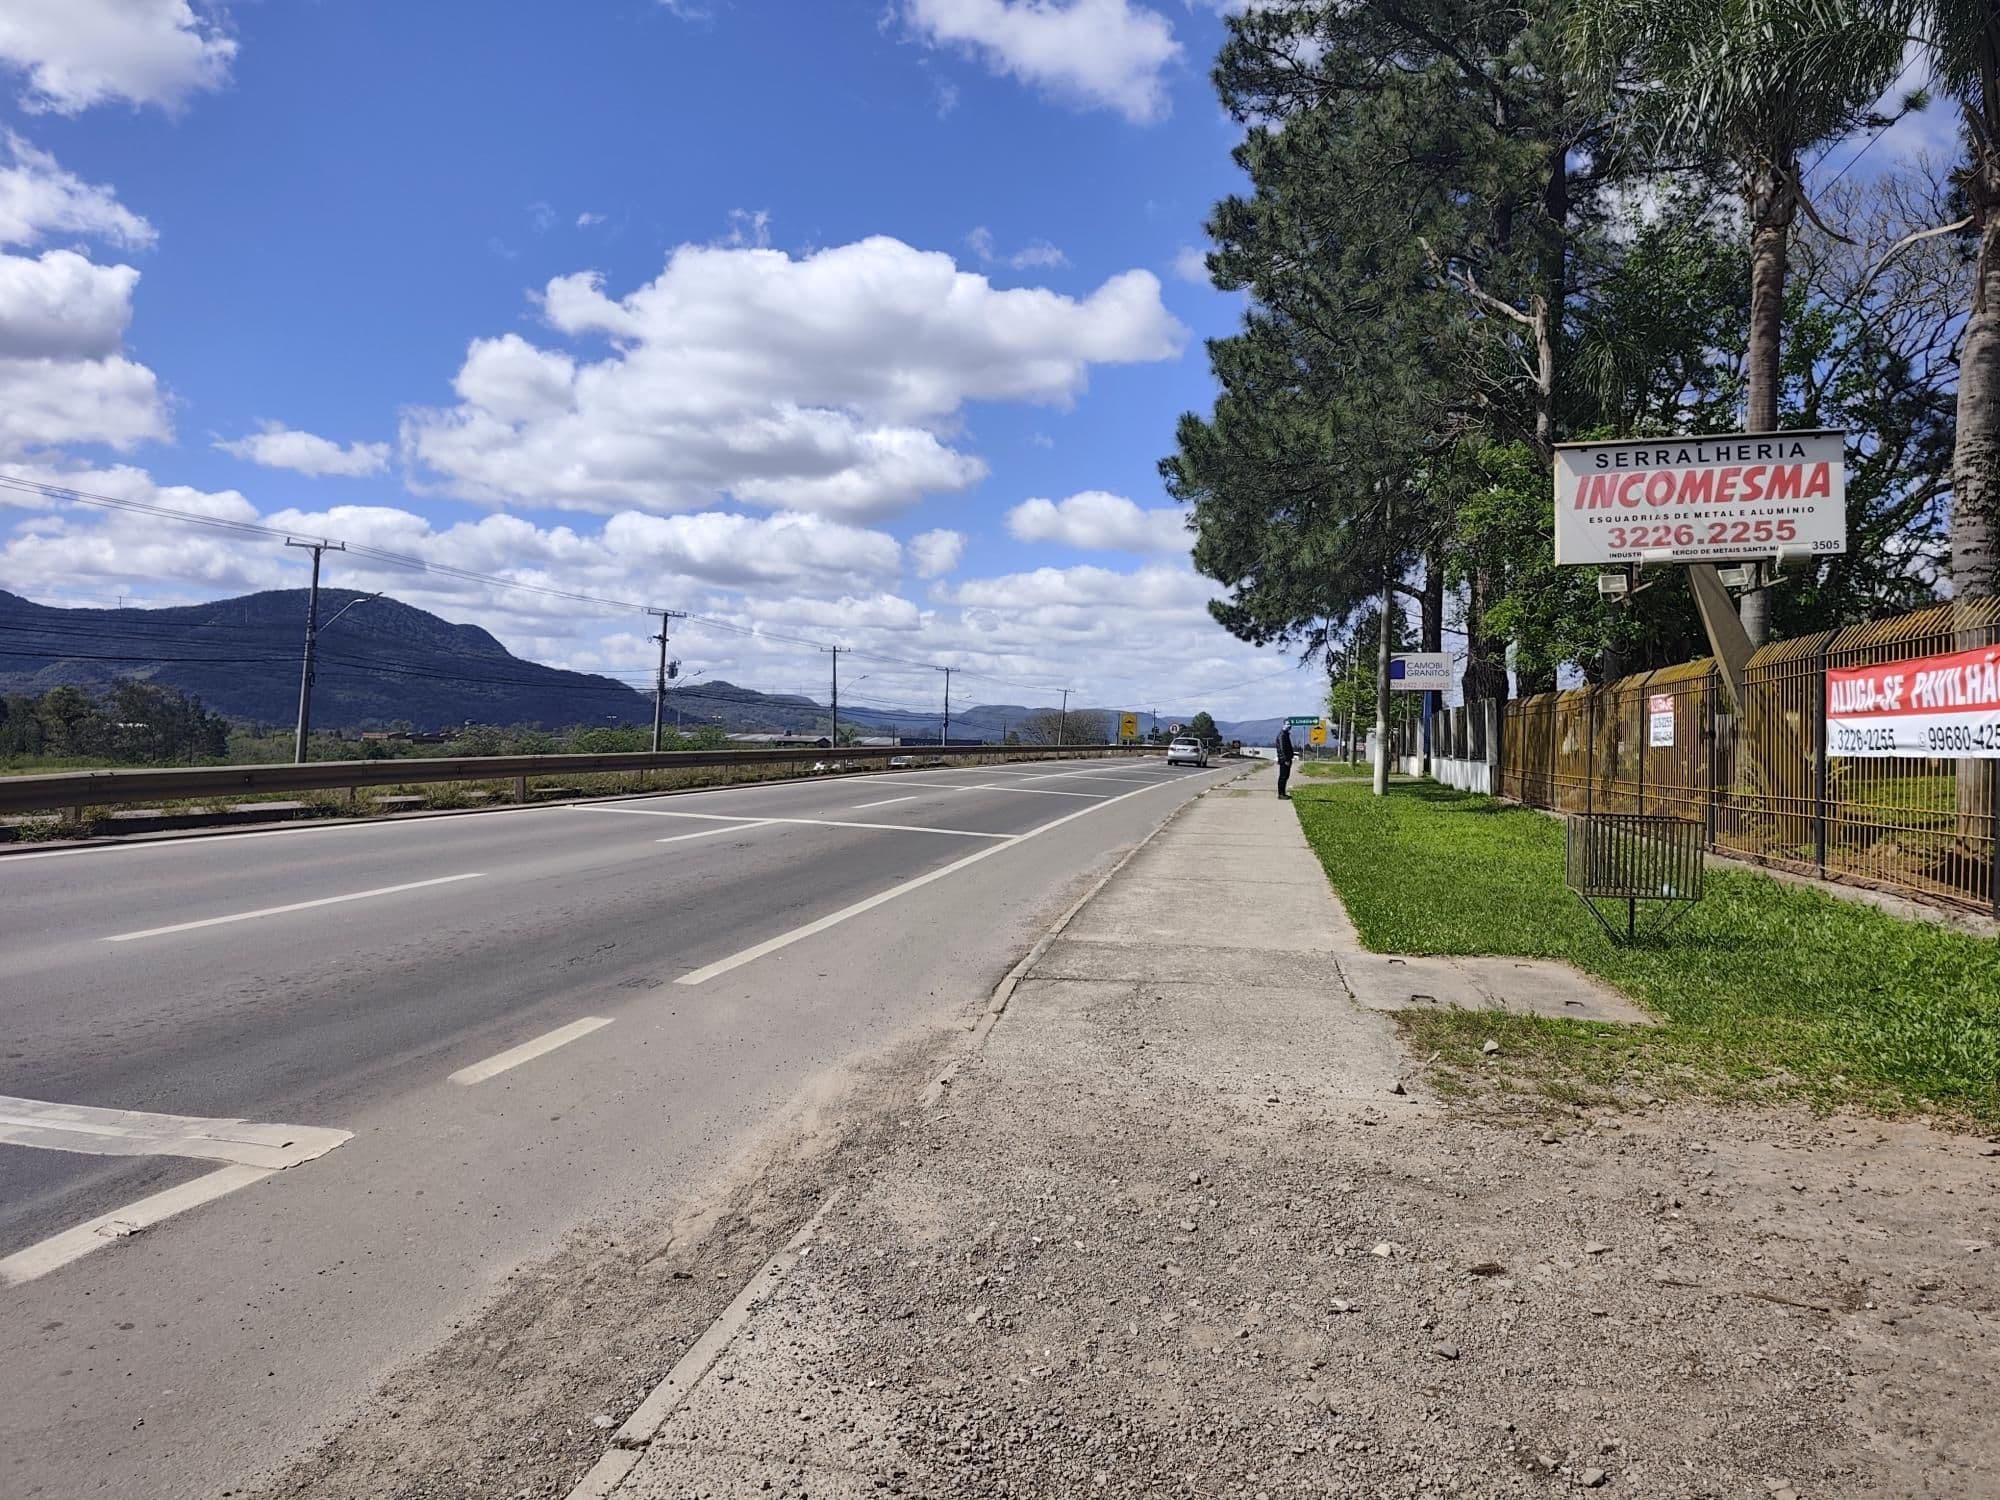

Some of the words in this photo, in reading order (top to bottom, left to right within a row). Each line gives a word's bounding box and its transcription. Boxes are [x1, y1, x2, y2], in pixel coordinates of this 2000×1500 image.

[1595, 442, 1806, 469] SERRALHERIA
[1573, 461, 1831, 510] INCOMESMA
[1589, 513, 1669, 524] ESQUADRIAS
[1674, 512, 1689, 520] DE
[1694, 510, 1735, 519] METAL
[1607, 519, 1797, 549] 3226.2255
[1812, 540, 1840, 550] 3505
[1830, 674, 1904, 714] ALUGA-SE
[1910, 652, 2000, 709] PAVILHÃ
[1837, 728, 1896, 751] 3226-2255
